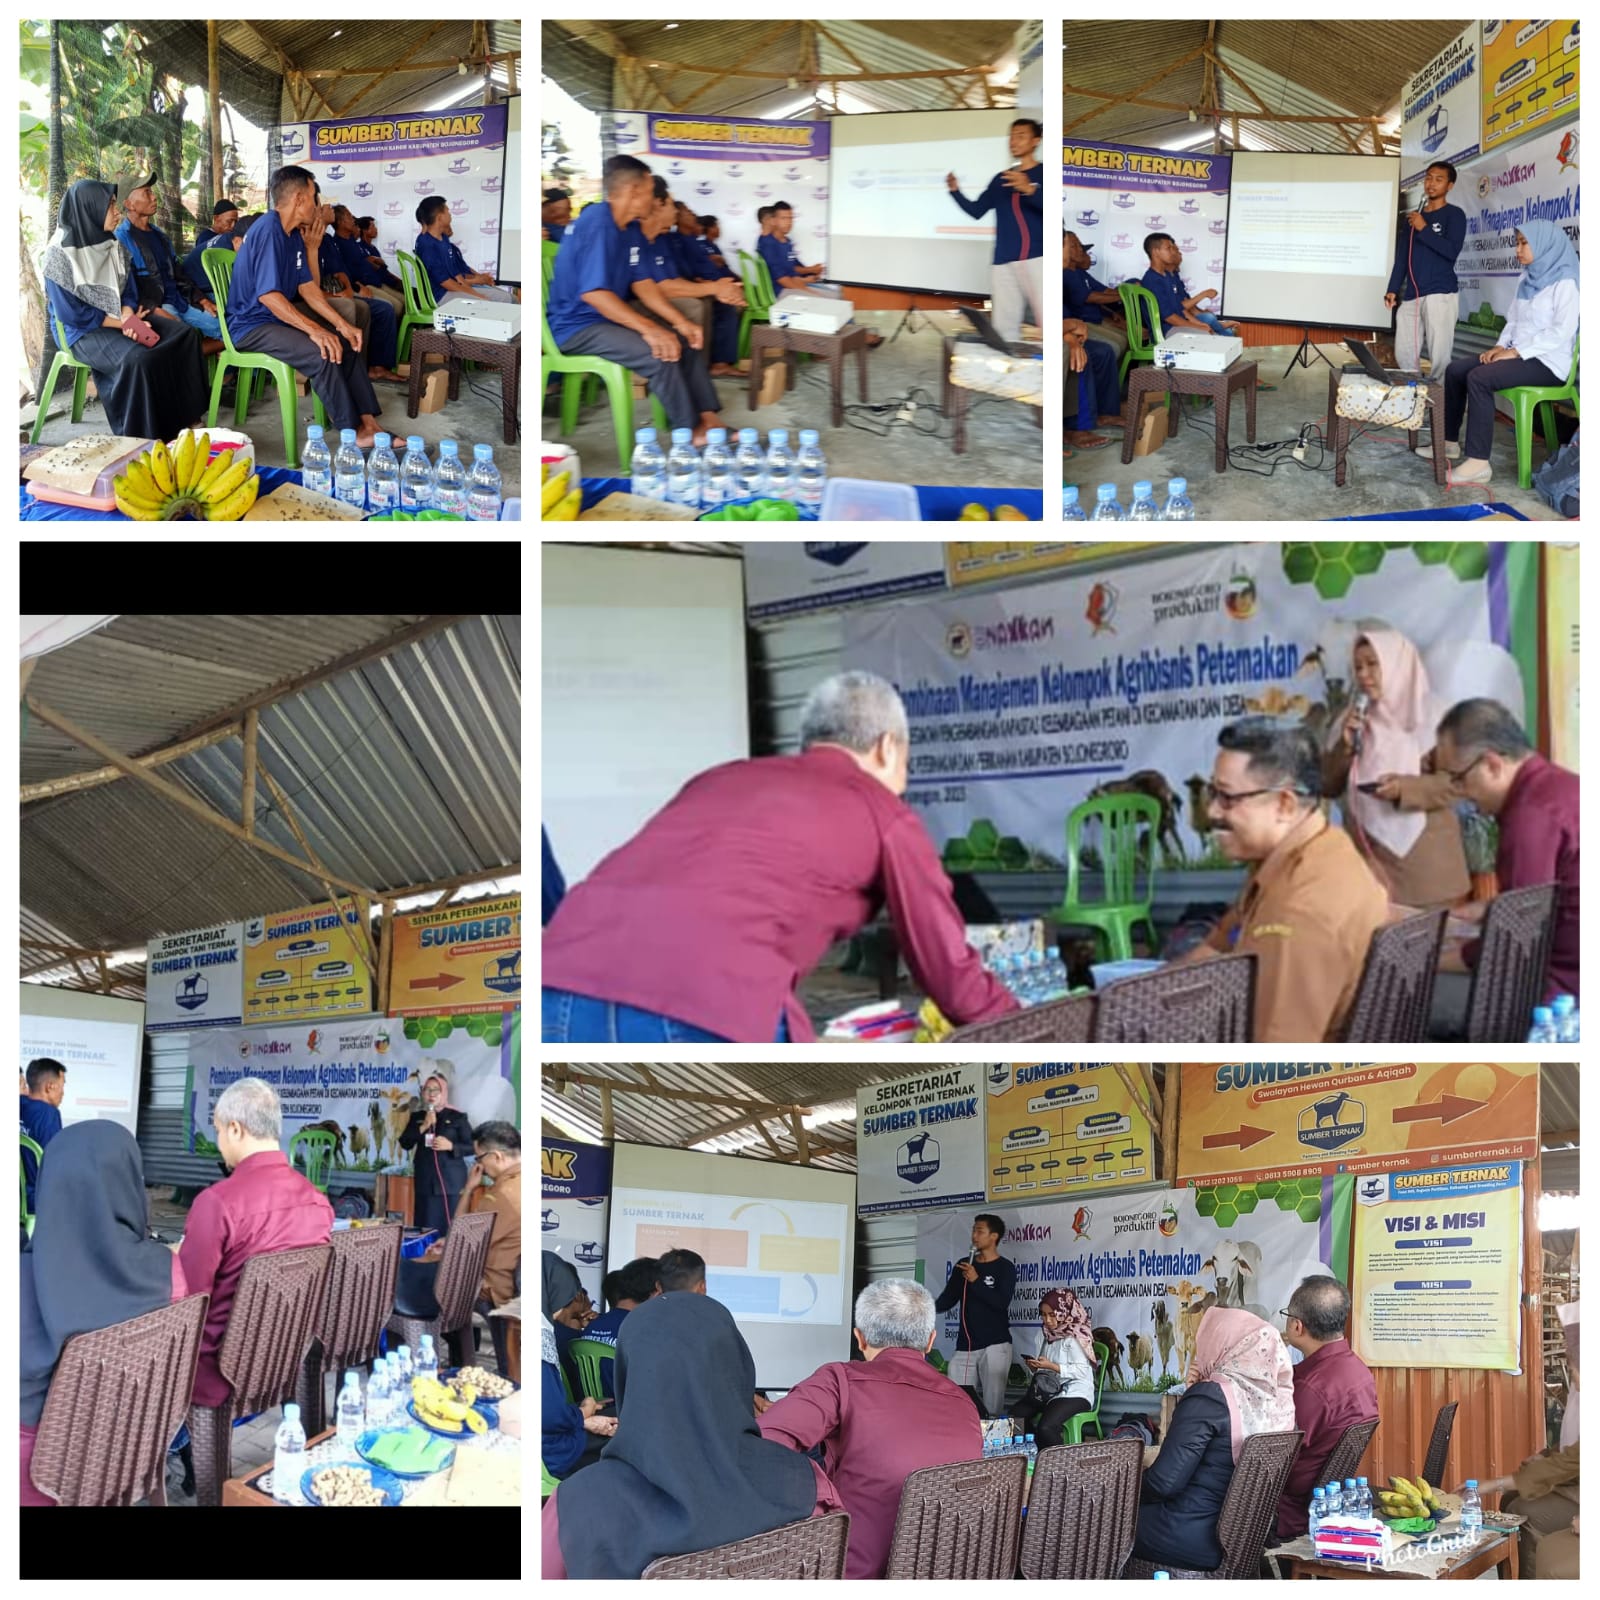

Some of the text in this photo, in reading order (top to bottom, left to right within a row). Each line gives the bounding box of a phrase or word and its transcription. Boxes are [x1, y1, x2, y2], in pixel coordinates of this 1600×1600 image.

[1411, 37, 1465, 92] SEKRETARIAT
[1446, 43, 1474, 71] TERNAK
[1435, 55, 1477, 99] TERNAK
[316, 113, 484, 147] SUMBER TERNAK
[1126, 152, 1212, 180] TERNAK
[1041, 656, 1112, 708] Kelompok
[1116, 644, 1195, 703] Agribisnis
[1198, 634, 1299, 686] Peternakan
[411, 899, 518, 926] SENTRA PETERNAKAN
[161, 928, 227, 950] SEKRETARIAT
[267, 921, 311, 941] SUMBER
[420, 915, 513, 949] SUMBER
[151, 947, 239, 975] SUMBER TERNAK
[152, 938, 237, 960] KELOMPOK TANI TERNAK
[358, 1062, 408, 1083] Peternakan
[1216, 1062, 1335, 1093] SUMBER
[1257, 1086, 1299, 1099] Swalayan
[1300, 1080, 1330, 1091] Hewan
[1331, 1074, 1366, 1087] Qurban
[1367, 1071, 1375, 1080] &
[1377, 1066, 1412, 1080] Aqiqah
[876, 1070, 962, 1102] SEKRETARIAT
[864, 1084, 976, 1117] KELOMPOK TANI TERNAK
[863, 1096, 980, 1138] SUMBER TERNAK
[1300, 1126, 1361, 1142] SUMBER TERNAK
[1442, 1145, 1523, 1161] sumberternak.id
[1264, 1171, 1282, 1180] 0813
[1347, 1161, 1380, 1171] sumber
[1381, 1157, 1411, 1167] ternak
[1394, 1165, 1511, 1189] SUMBER TERNAK
[623, 1207, 705, 1221] SUMBER TERNAK
[1113, 1211, 1157, 1223] BOJONEGORO
[1384, 1212, 1486, 1233] VISI & MISI
[1114, 1219, 1157, 1236] produktif
[1423, 1239, 1443, 1247] VISI
[1041, 1253, 1085, 1286] Kelompok
[1086, 1250, 1137, 1285] Agribisnis
[1138, 1247, 1201, 1277] Peternakan
[1102, 1284, 1138, 1299] KECAMATAN
[1138, 1283, 1152, 1298] DAN
[1152, 1283, 1168, 1297] DESA
[1421, 1280, 1444, 1289] MISI
